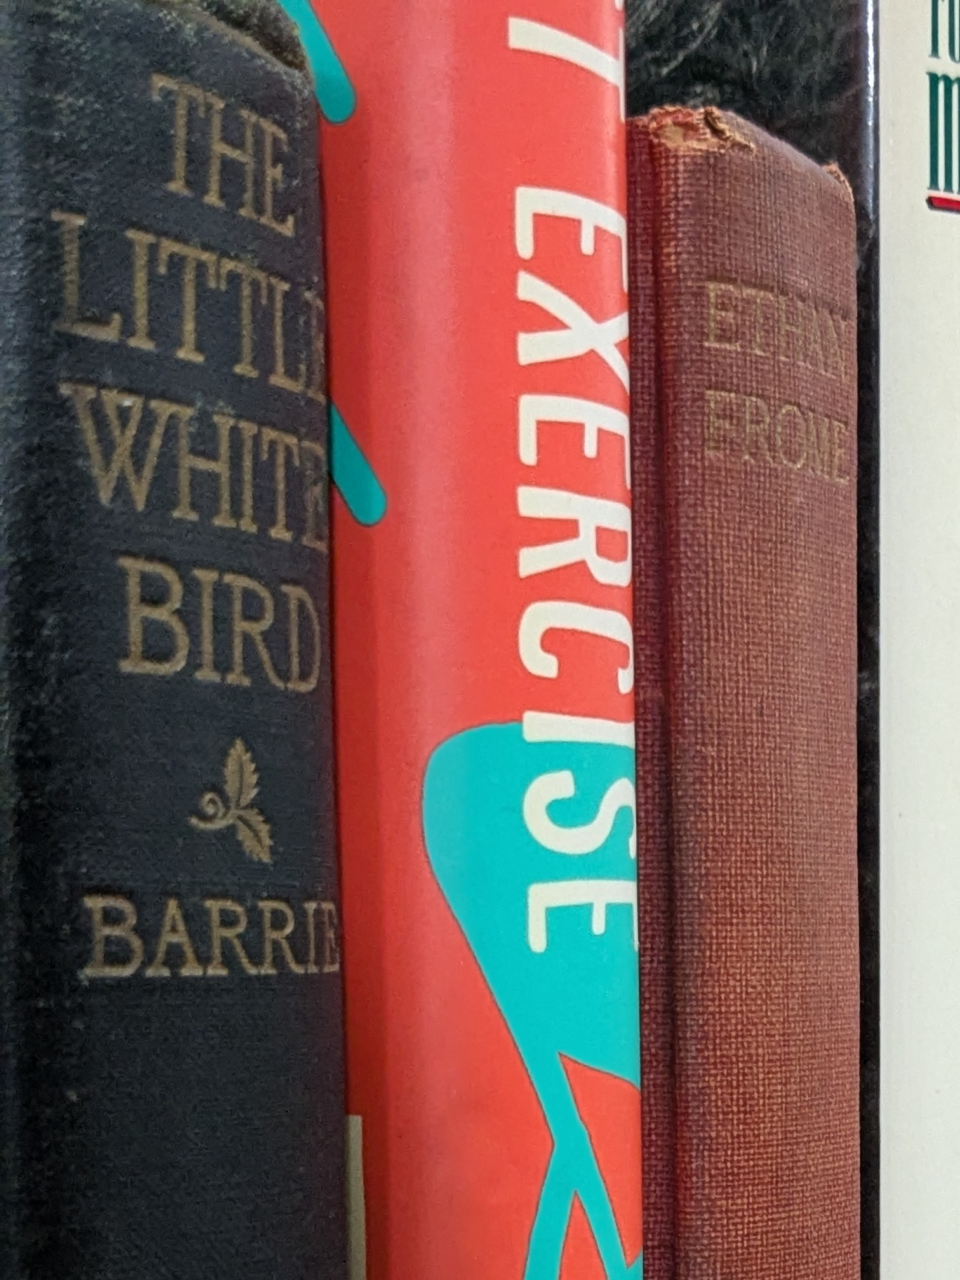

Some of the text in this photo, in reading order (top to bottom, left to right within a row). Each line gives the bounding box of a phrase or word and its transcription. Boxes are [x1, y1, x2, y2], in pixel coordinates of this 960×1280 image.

[151, 72, 294, 237] THE
[51, 209, 326, 405] LITTLE
[58, 382, 328, 552] WHITE
[117, 556, 322, 694] BIRD
[514, 186, 638, 959] EXERCISE
[82, 893, 340, 977] BARRIE
